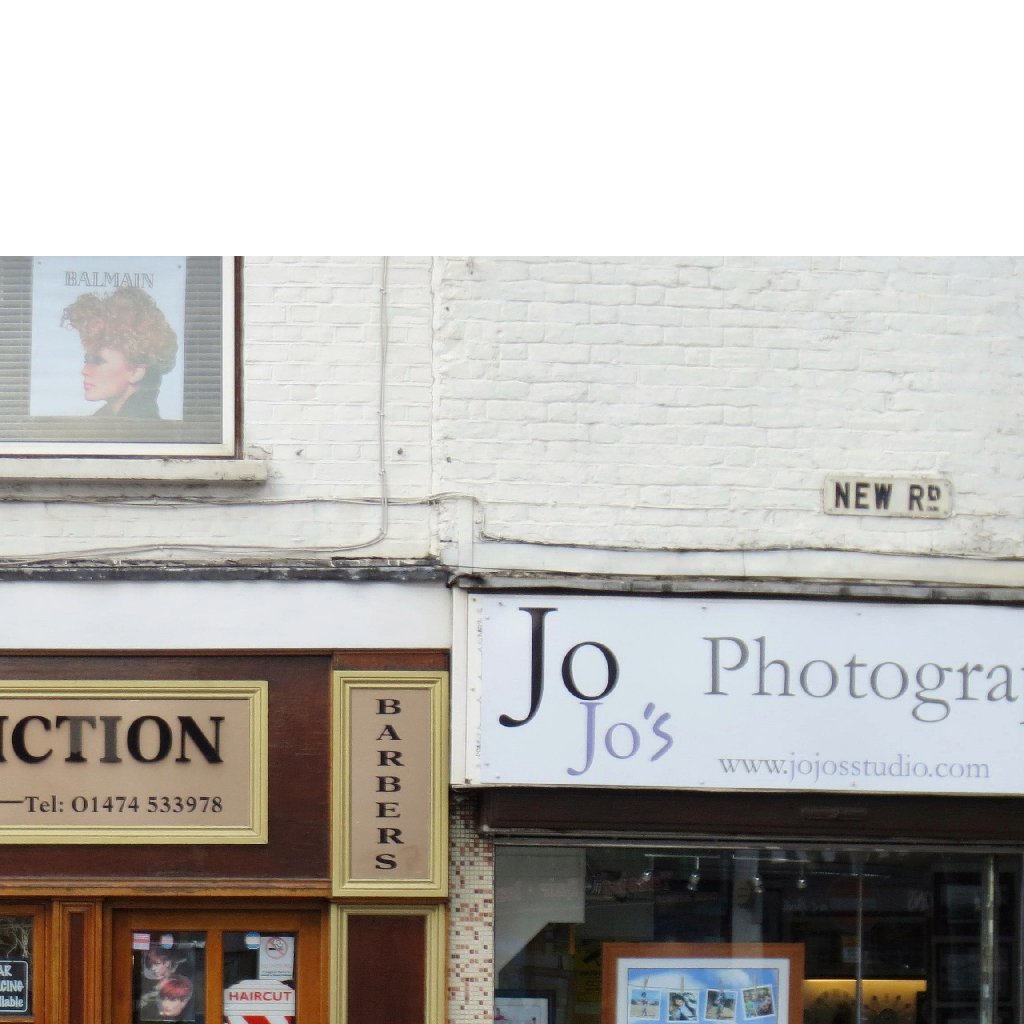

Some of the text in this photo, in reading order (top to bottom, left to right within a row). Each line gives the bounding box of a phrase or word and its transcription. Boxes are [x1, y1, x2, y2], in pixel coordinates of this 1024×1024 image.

[64, 271, 154, 289] BALMAIN
[835, 481, 893, 510] NEW
[498, 606, 620, 728] Jo
[702, 635, 1024, 723] Photogra
[566, 702, 674, 776] Jo's
[718, 752, 991, 783] www.jojosstudio.com
[375, 698, 405, 870] BARBERS
[24, 795, 64, 814] Tel:
[71, 796, 140, 814] 01474
[147, 797, 224, 814] 533978
[229, 991, 292, 1002] HAIRCUT
